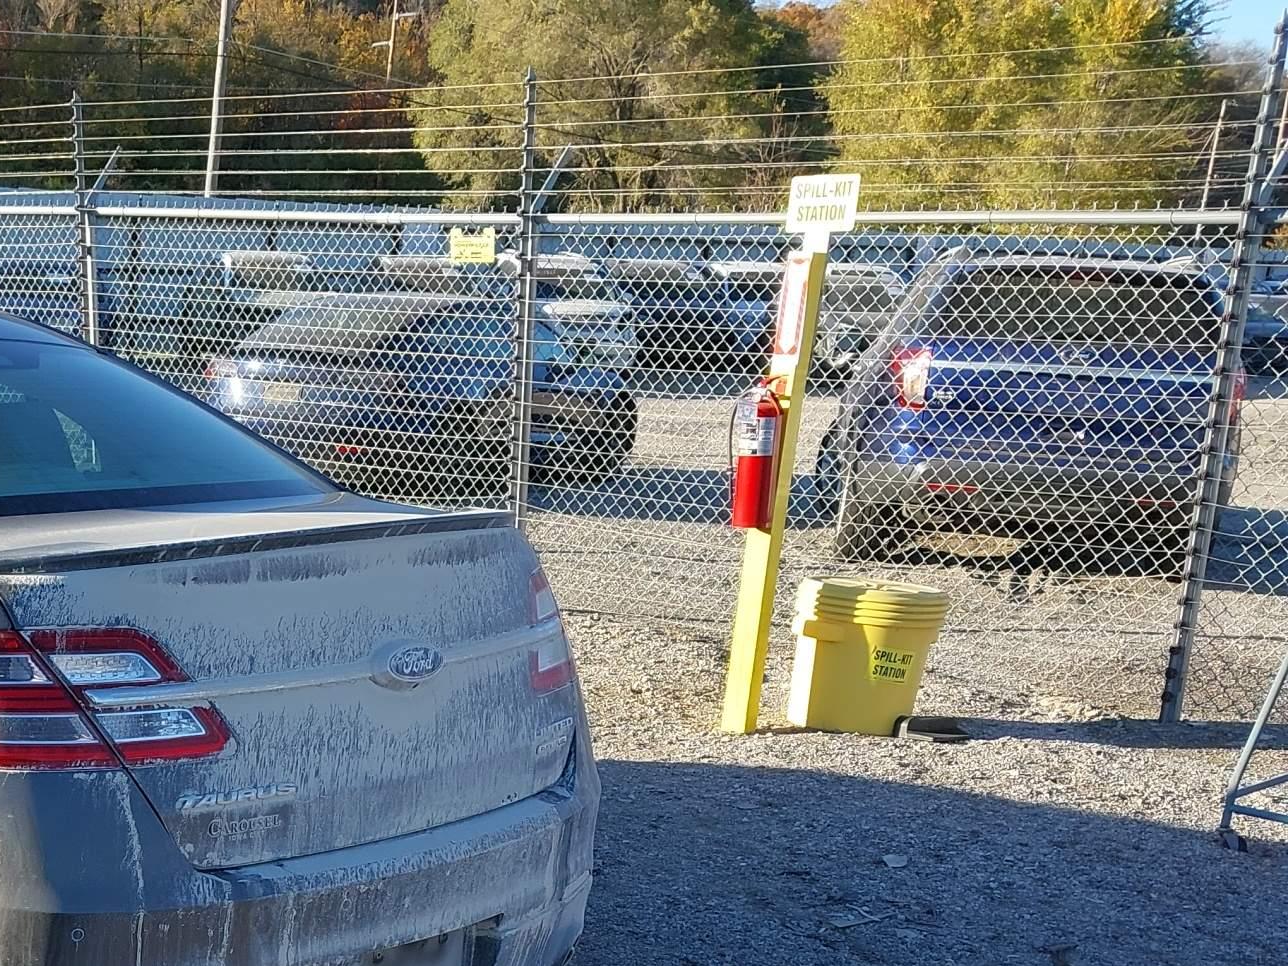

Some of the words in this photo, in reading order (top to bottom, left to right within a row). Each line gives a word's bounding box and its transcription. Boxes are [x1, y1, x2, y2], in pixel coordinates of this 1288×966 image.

[795, 181, 854, 199] SPILL-KIT
[796, 204, 847, 222] STATION
[873, 649, 913, 665] SPILL-KIT
[872, 664, 907, 680] STATION
[176, 786, 298, 811] TAURUS
[208, 814, 281, 837] CAROUSEL
